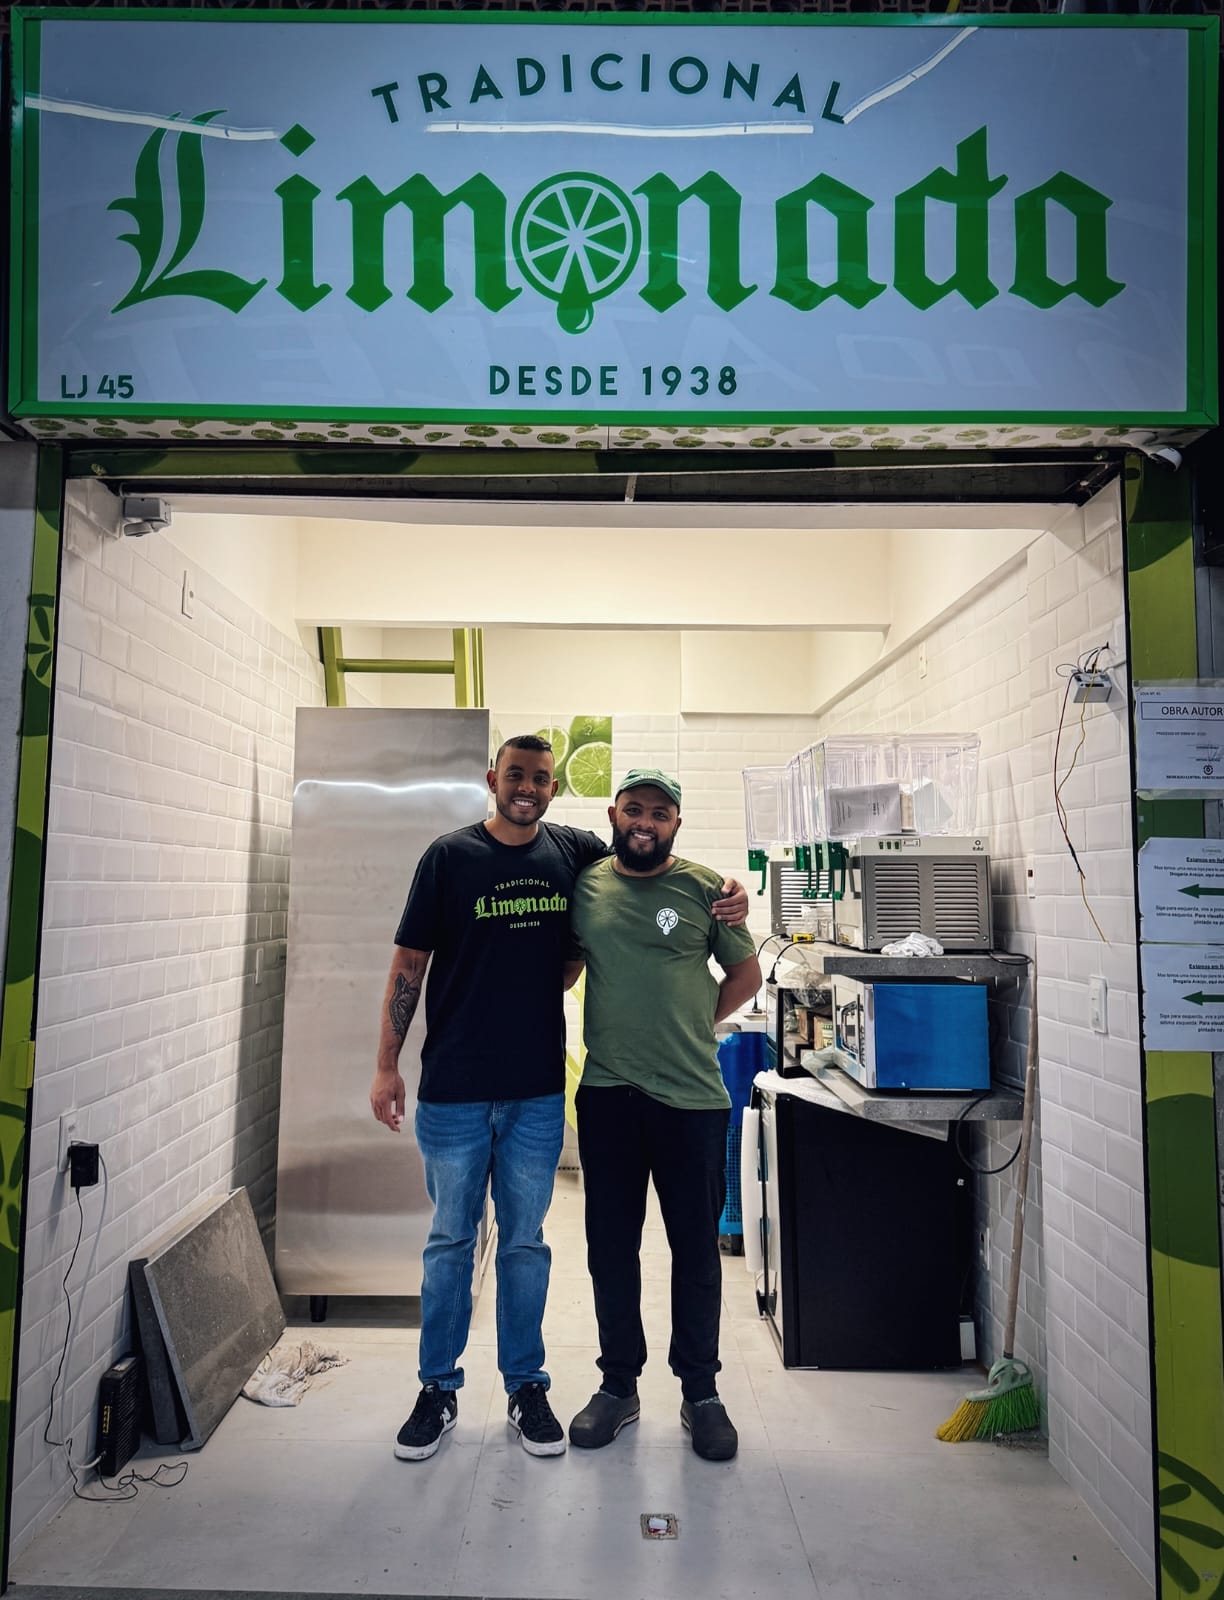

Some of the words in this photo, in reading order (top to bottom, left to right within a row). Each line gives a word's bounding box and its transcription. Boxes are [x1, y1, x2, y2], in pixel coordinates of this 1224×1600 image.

[370, 52, 846, 125] TRADICIONAL
[106, 109, 1127, 335] Limonada
[60, 374, 88, 400] LJ
[97, 374, 135, 400] 45
[489, 365, 618, 396] DESDE
[641, 365, 738, 397] 1938
[1161, 706, 1189, 716] OBRA
[494, 878, 550, 891] TRADICIONAL
[473, 891, 568, 920] Limonada
[509, 921, 527, 929] DESDE
